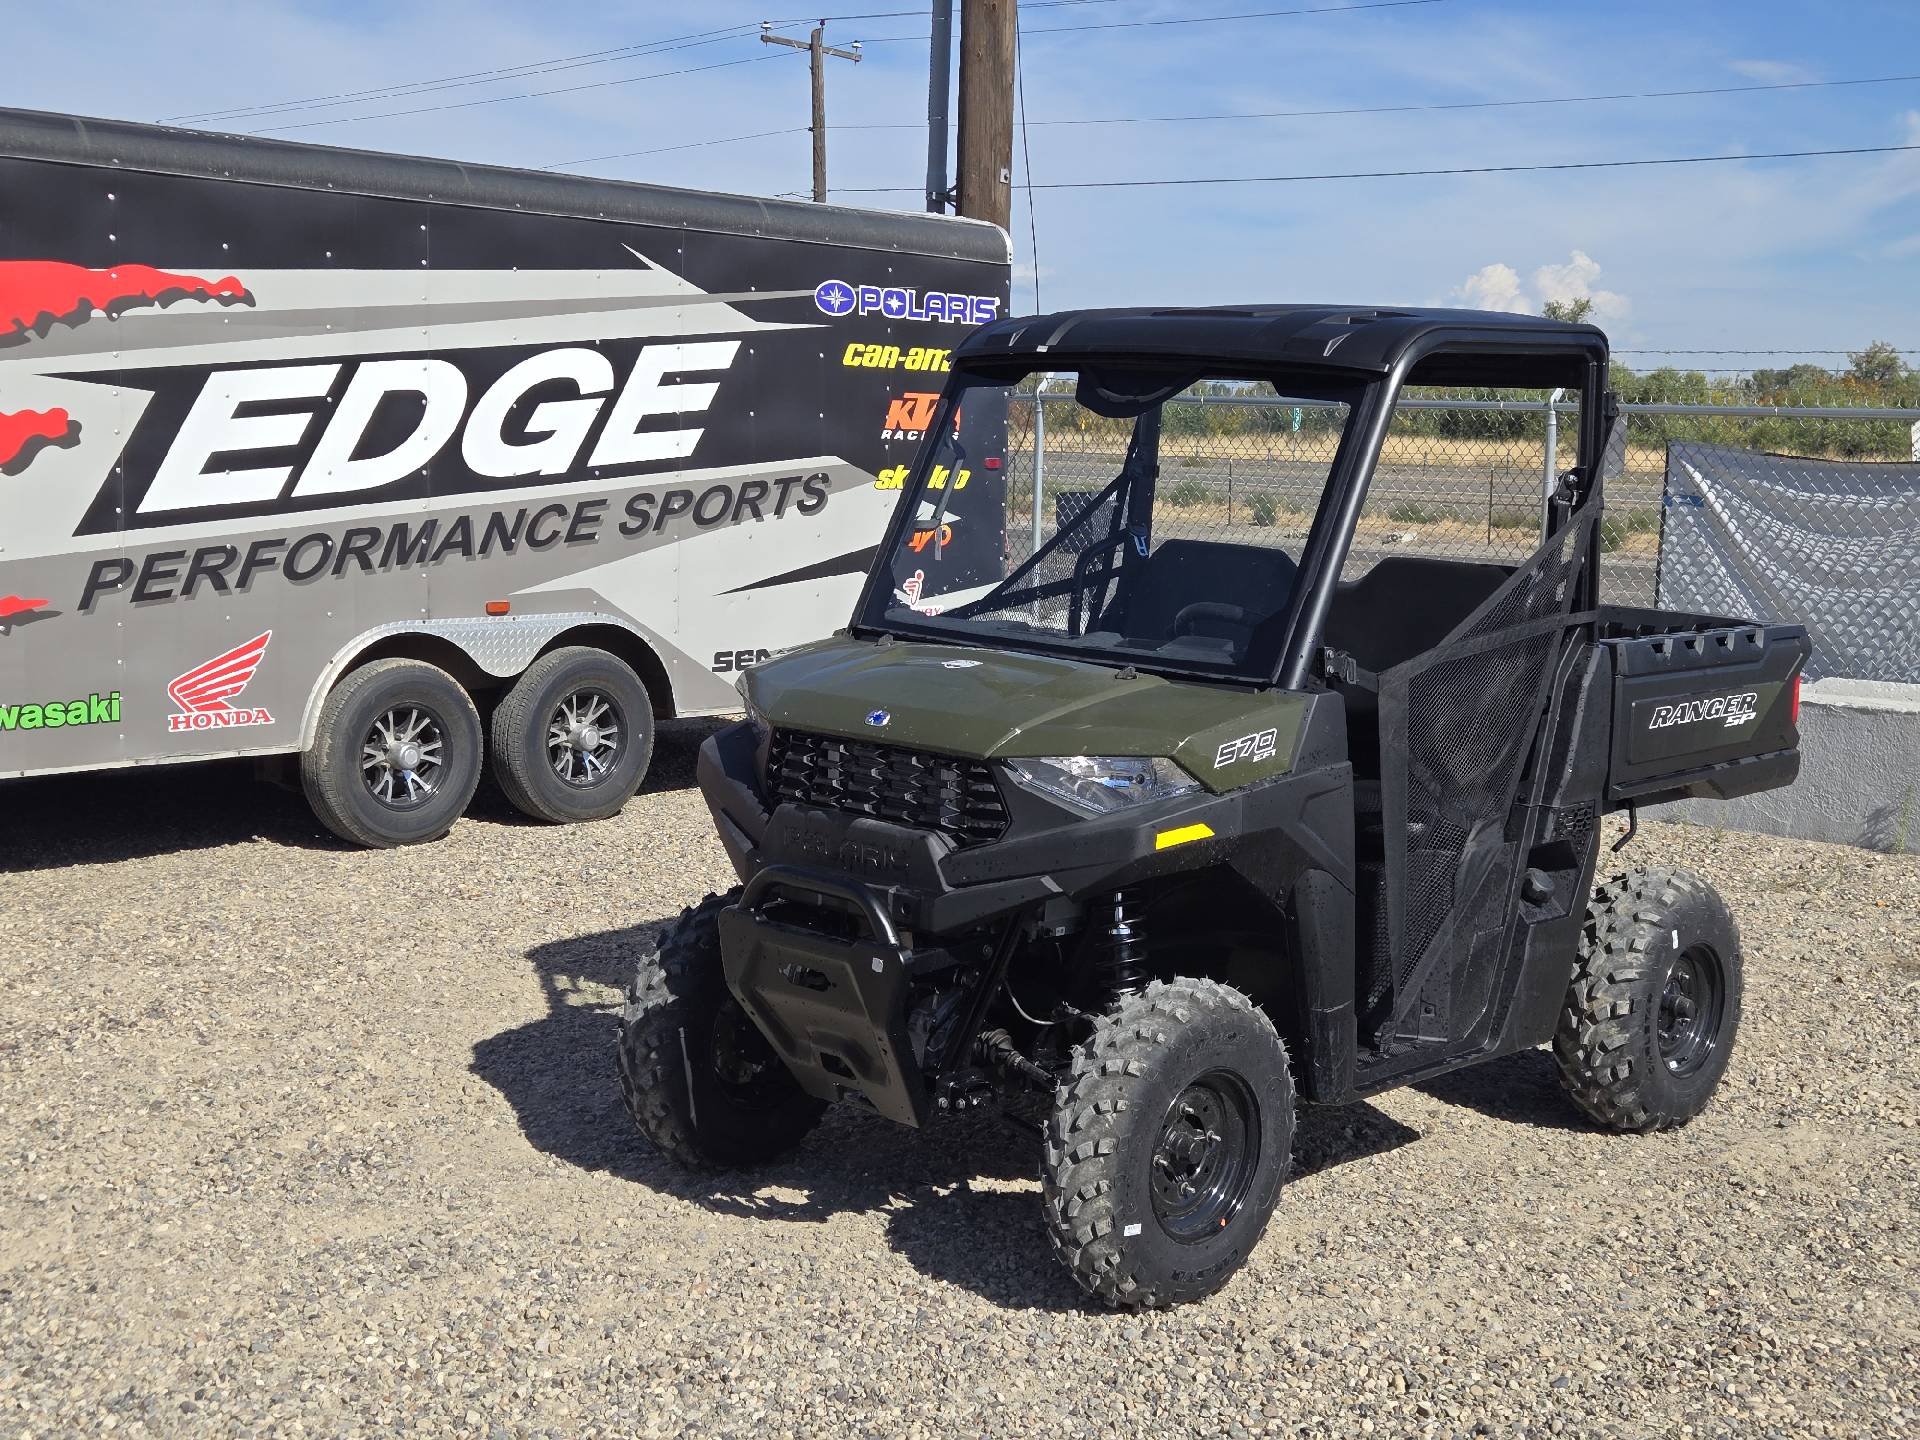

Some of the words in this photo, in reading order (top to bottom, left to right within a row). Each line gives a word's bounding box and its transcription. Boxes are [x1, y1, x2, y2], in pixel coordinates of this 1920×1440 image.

[858, 285, 999, 325] POLARIS
[136, 340, 742, 513] EDGE
[77, 498, 611, 616] PERFORMANCE
[618, 472, 832, 538] SPORTS
[168, 707, 275, 732] HONDA
[1648, 692, 1758, 729] RANGER
[1723, 712, 1757, 727] SP
[1213, 728, 1278, 769] 570
[1252, 749, 1277, 763] EFI
